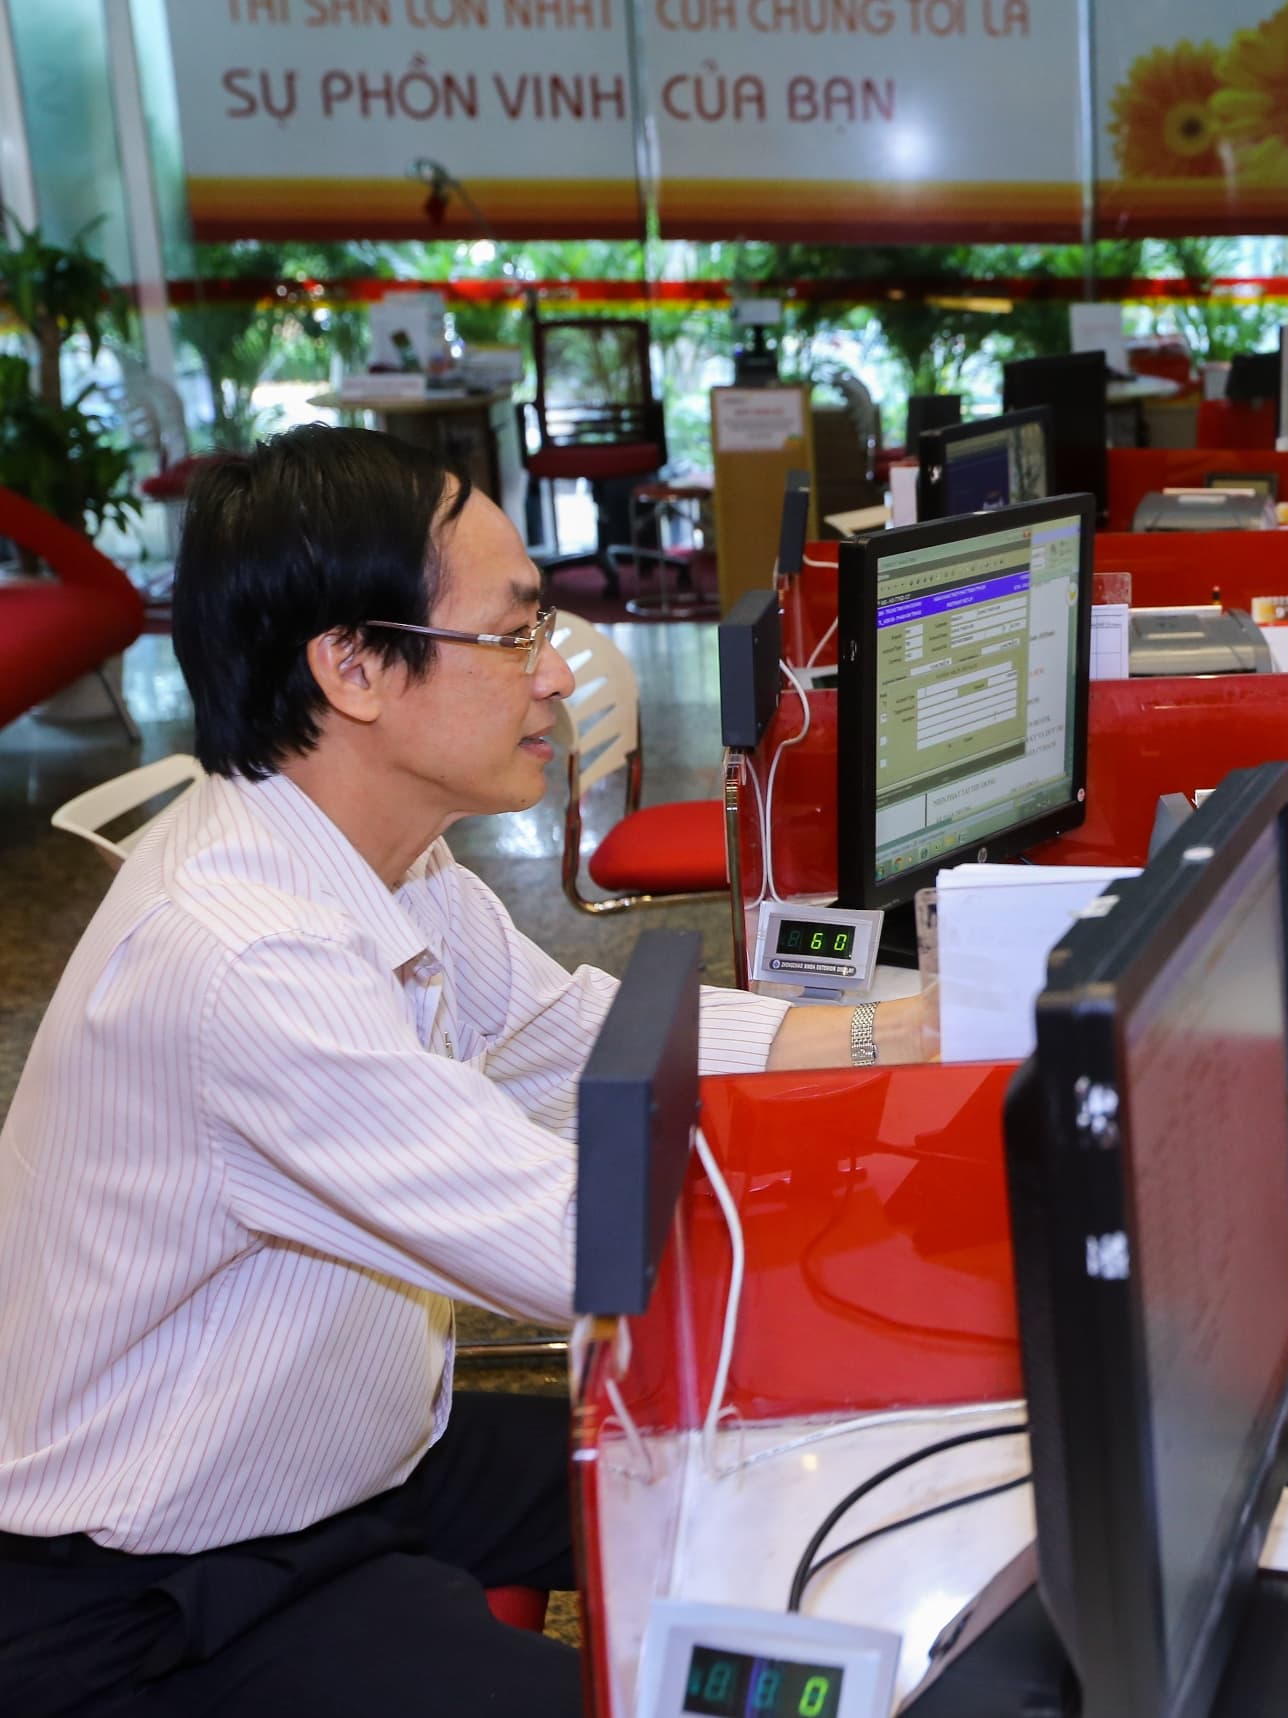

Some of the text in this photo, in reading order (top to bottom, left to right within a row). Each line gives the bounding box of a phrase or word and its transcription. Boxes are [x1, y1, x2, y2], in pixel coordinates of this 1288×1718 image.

[222, 68, 298, 127] SỰ
[493, 71, 627, 120] VINH
[662, 60, 767, 122] CỦA
[787, 75, 896, 132] BẠN
[810, 933, 848, 951] 60
